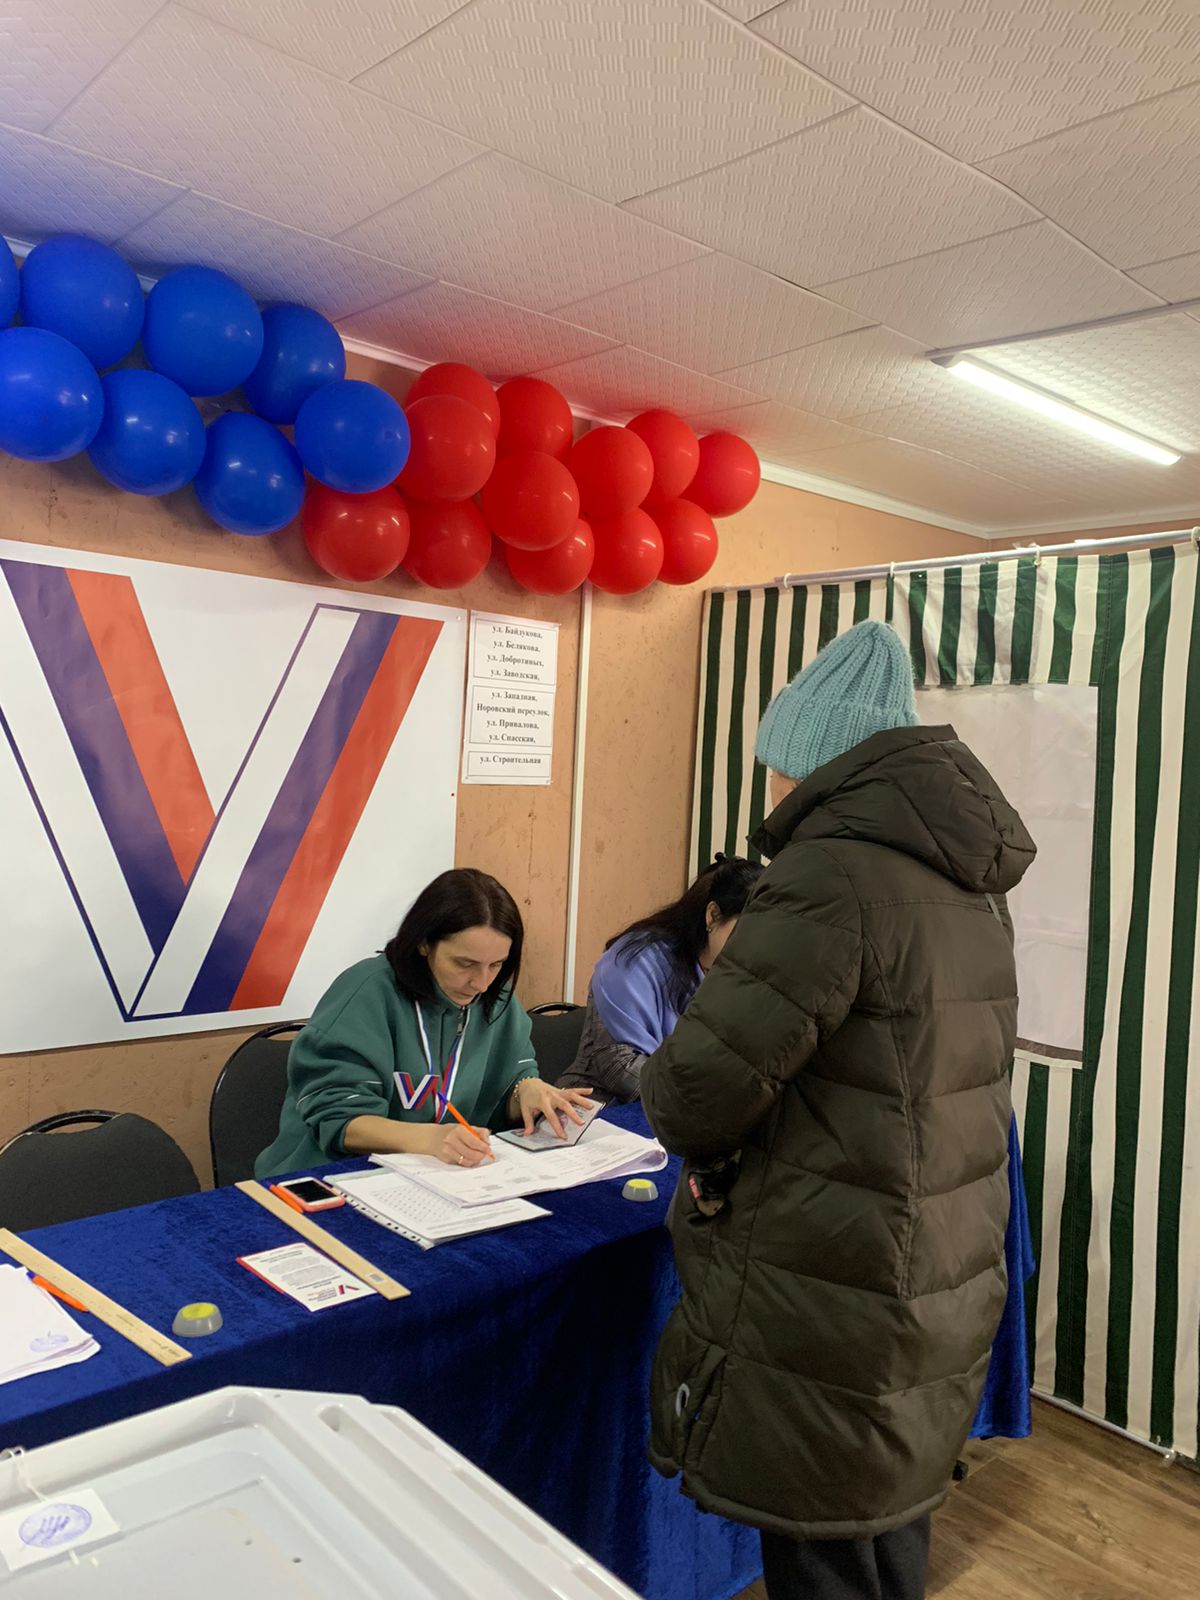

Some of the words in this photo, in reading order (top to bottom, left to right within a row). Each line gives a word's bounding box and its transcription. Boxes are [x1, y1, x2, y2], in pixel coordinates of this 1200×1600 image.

[492, 625, 502, 634] ул.
[493, 640, 504, 649] ул.
[506, 640, 541, 652] Белякова,
[487, 654, 498, 663] ул.
[490, 669, 501, 677] ул.
[491, 691, 502, 700] ул.
[476, 703, 516, 714] Норовский
[486, 720, 498, 728] ул.
[499, 719, 540, 729] Привалова,
[488, 734, 500, 742] ул.
[501, 733, 536, 743] Спасская,
[479, 756, 492, 764] ул.
[492, 754, 542, 765] Строительная
